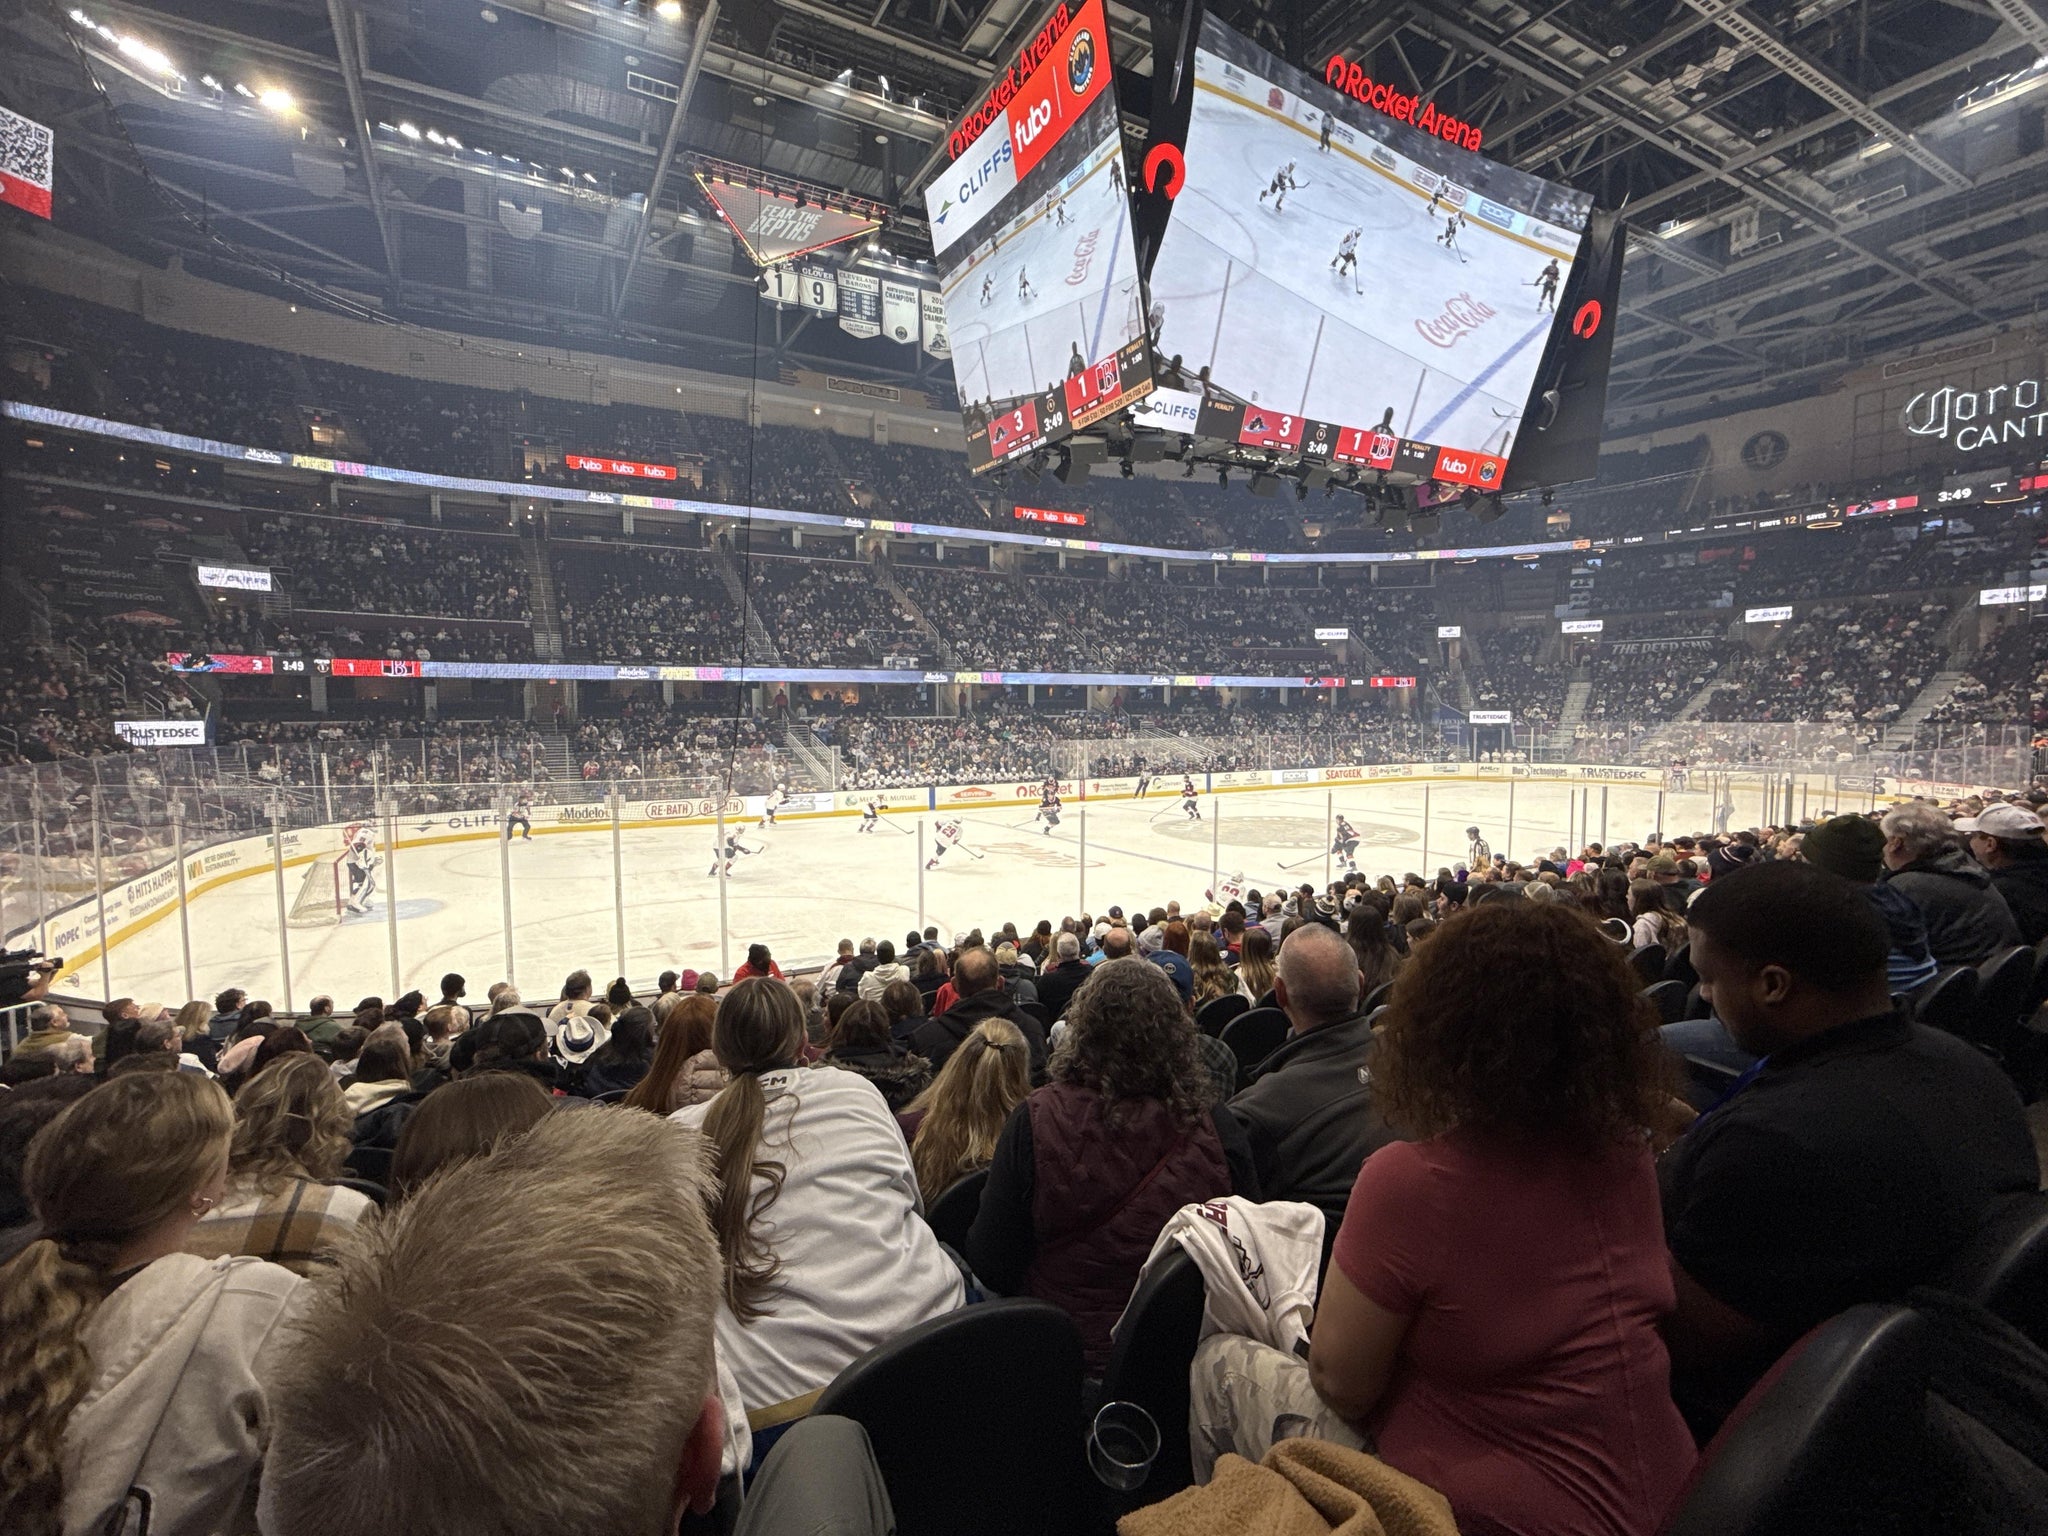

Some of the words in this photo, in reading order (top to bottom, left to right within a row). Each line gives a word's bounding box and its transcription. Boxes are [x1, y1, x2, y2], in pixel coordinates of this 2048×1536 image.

[960, 68, 1018, 147] Rocket
[1018, 2, 1071, 86] Arena
[1344, 62, 1419, 127] Rocket
[1418, 102, 1482, 152] Arena
[1014, 98, 1052, 154] fubo
[958, 139, 1013, 204] CLIFFS
[761, 204, 796, 220] FEAR
[798, 211, 823, 225] THE
[747, 215, 815, 242] DEPTHS
[801, 267, 835, 281] GLOVER
[839, 272, 878, 285] CLEVELAND
[774, 273, 783, 297] 1
[845, 280, 872, 290] BARONS
[813, 281, 824, 305] 9
[884, 291, 916, 304] CHAMPIONS
[1121, 362, 1128, 371] 14
[1078, 375, 1087, 397] 1
[1154, 401, 1197, 420] CLIFFS
[1014, 410, 1024, 431] 3
[1044, 411, 1063, 432] 3:49
[1279, 416, 1292, 437] 3
[1353, 431, 1363, 451] 1
[1307, 441, 1328, 455] 3:49
[579, 459, 602, 471] fubo
[612, 463, 635, 474] fubo
[644, 466, 666, 477] fubo
[1442, 457, 1467, 474] fubo
[1938, 488, 1972, 502] 3:49
[1887, 499, 1897, 510] 3
[1806, 512, 1827, 521] SAVES
[1832, 508, 1840, 518] 7
[1759, 519, 1781, 528] SHOTS
[1784, 516, 1797, 525] 12
[227, 574, 269, 585] CLIFFS
[1612, 643, 1640, 655] THE
[252, 660, 263, 671] 3
[283, 660, 304, 671] 3:49
[348, 662, 354, 673] 1
[618, 666, 649, 679] Modelo
[122, 728, 198, 738] TRUSTEDSEC
[1326, 769, 1362, 780] SEATGEEK
[1530, 767, 1567, 778] Technologies
[1580, 767, 1646, 779] TRUSTEDSEC
[890, 794, 916, 802] MUTUAL
[564, 807, 605, 820] Modelo
[217, 850, 236, 861] DRIVING
[188, 859, 203, 880] WM
[135, 880, 152, 899] HITS
[152, 869, 174, 891] HAPPEN
[55, 926, 80, 950] NOPEC
